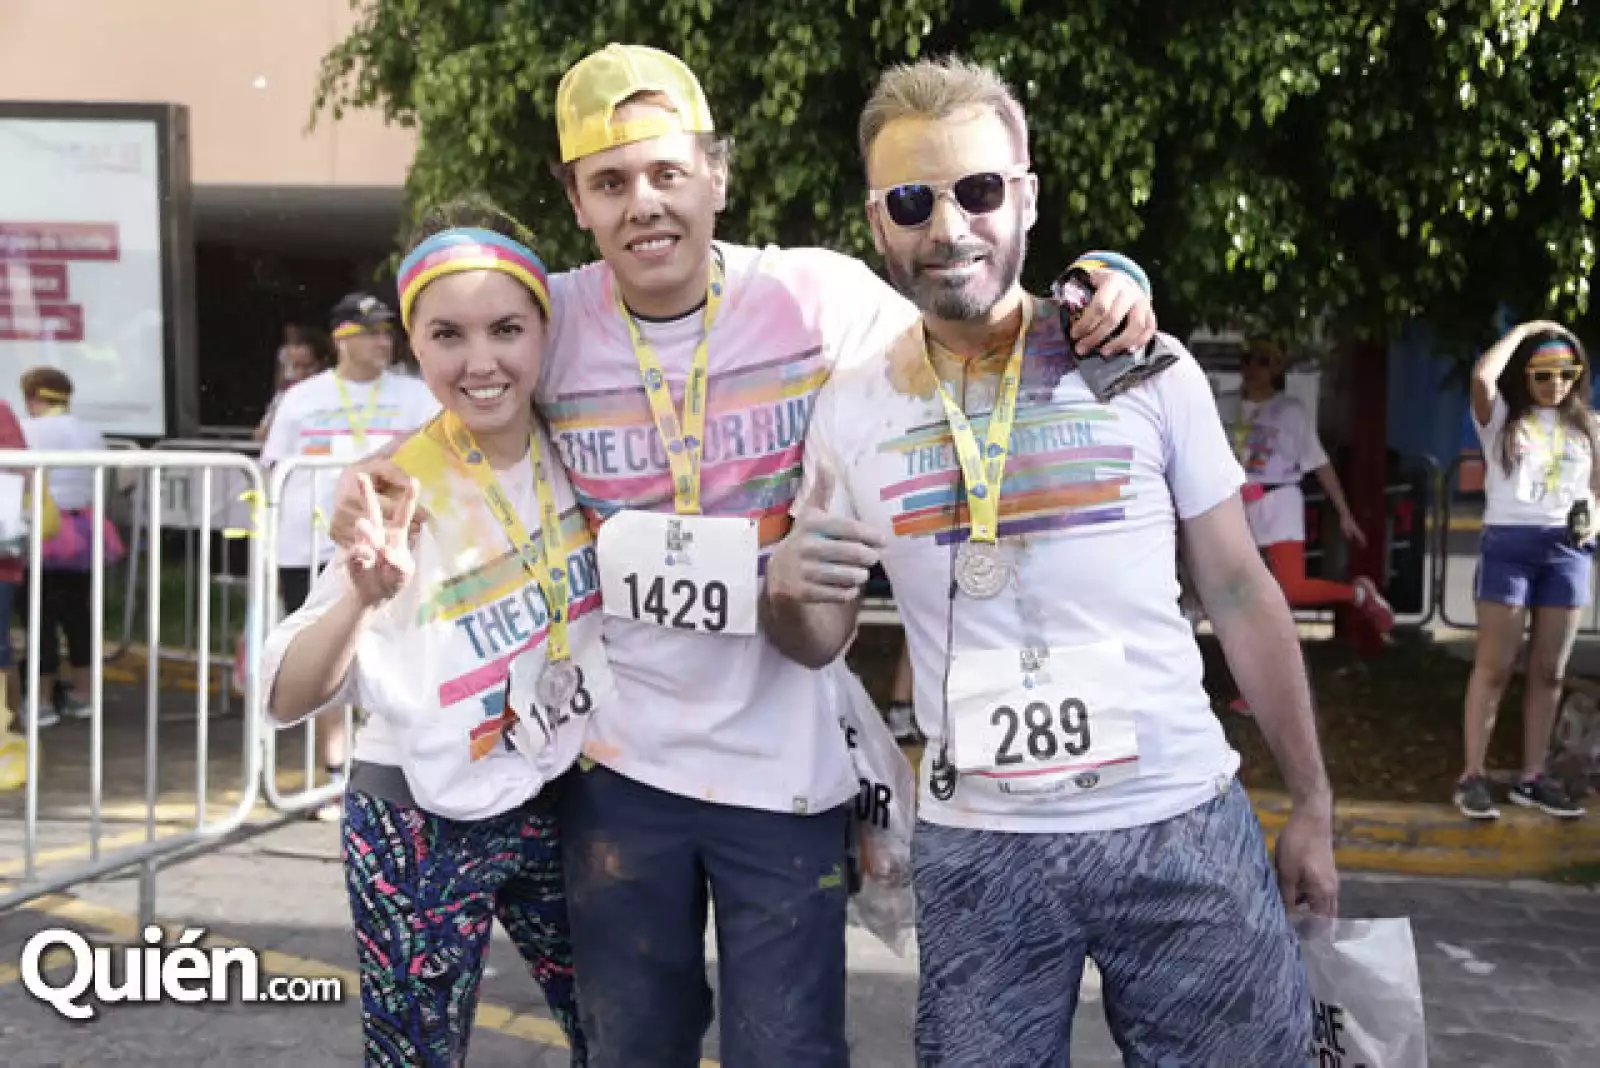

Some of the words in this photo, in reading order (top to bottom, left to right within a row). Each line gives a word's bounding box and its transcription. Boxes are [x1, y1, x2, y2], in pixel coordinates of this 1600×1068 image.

[559, 428, 618, 474] THE
[902, 444, 948, 476] THE
[457, 598, 530, 659] THE
[623, 573, 728, 631] 1429
[991, 698, 1091, 766] 289
